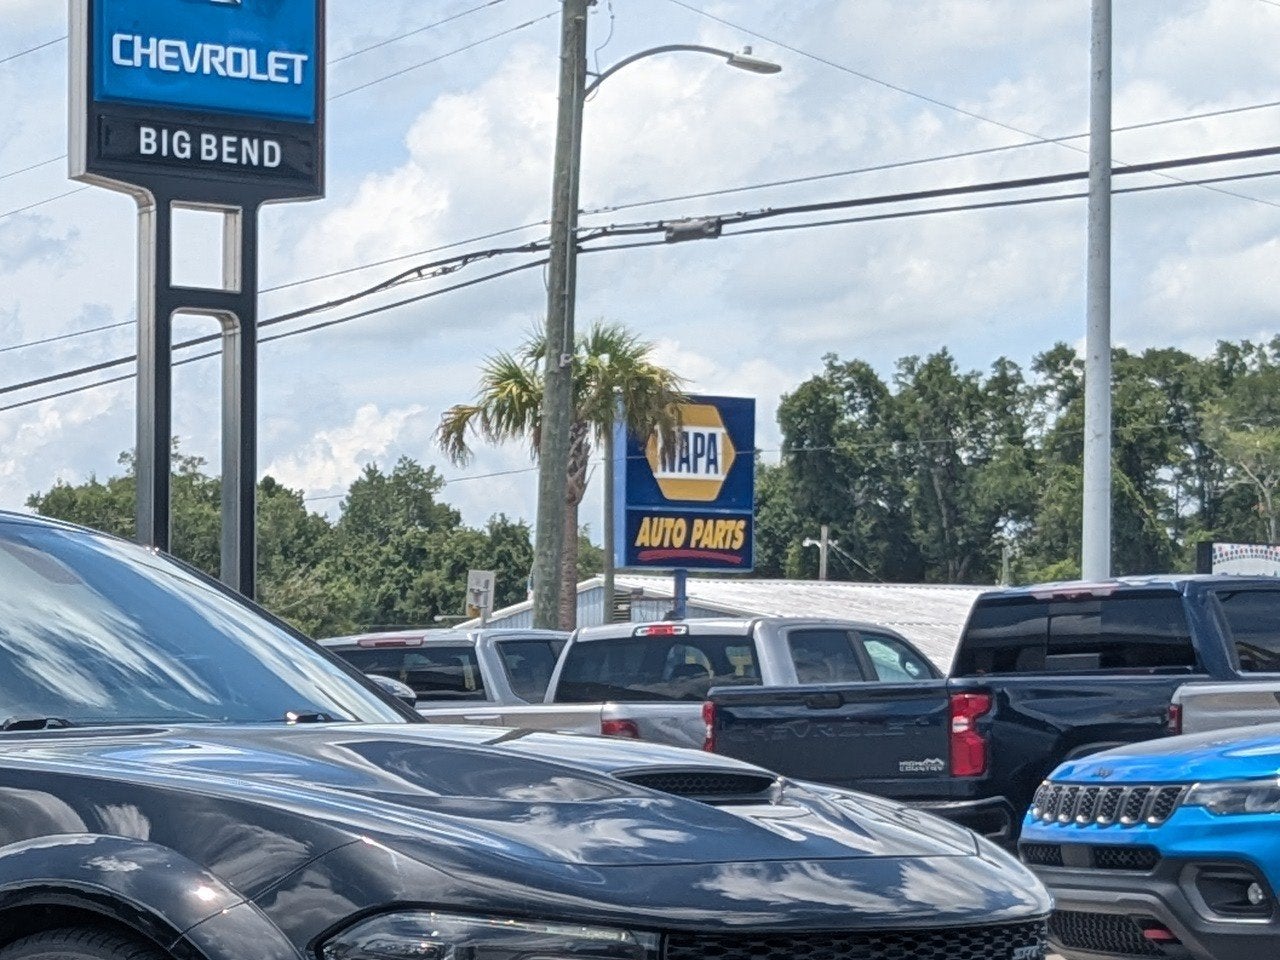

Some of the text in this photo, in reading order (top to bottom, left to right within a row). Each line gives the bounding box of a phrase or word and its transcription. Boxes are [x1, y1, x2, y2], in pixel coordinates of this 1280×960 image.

[112, 33, 308, 85] CHEVROLET
[139, 126, 282, 168] BIG BEND
[635, 517, 746, 550] AUTO PARTS
